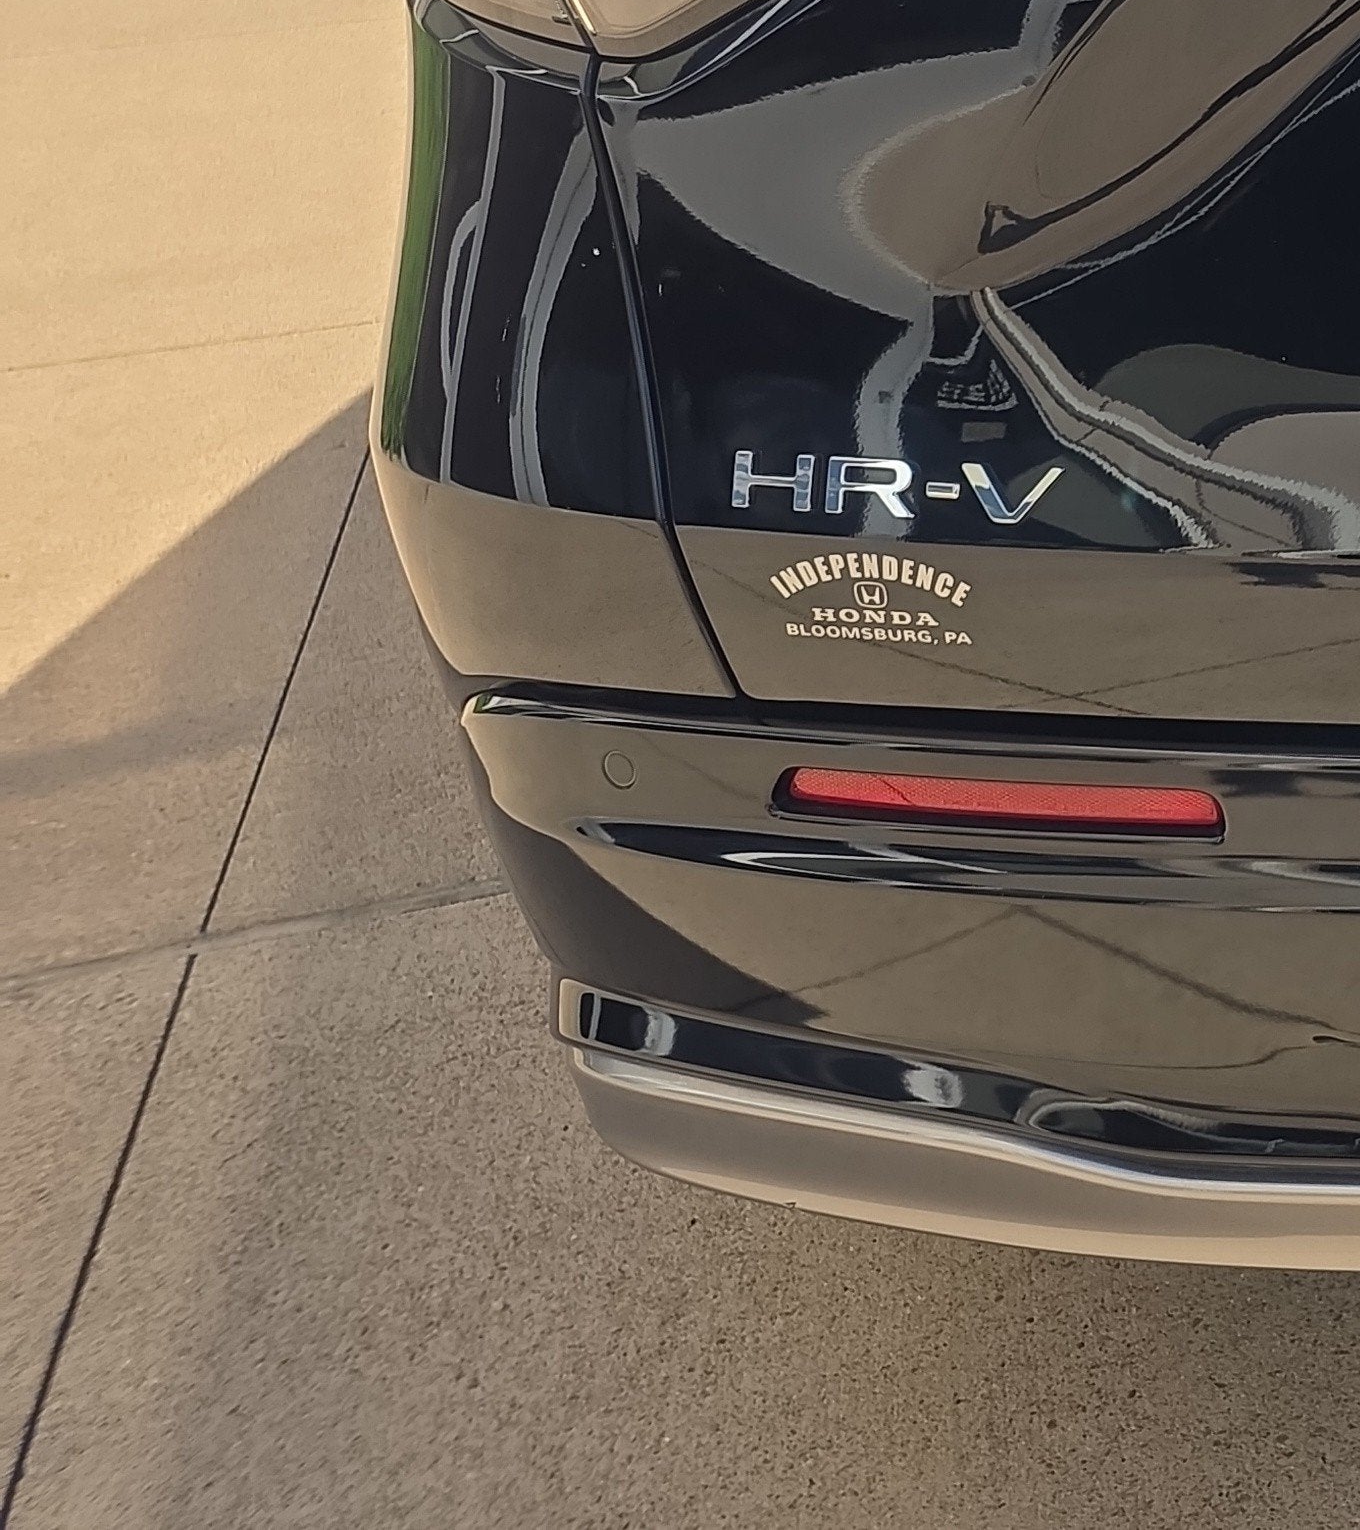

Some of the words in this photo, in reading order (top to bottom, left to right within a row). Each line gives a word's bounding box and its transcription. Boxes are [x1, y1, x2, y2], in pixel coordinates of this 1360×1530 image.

[731, 450, 1066, 525] HR-V
[769, 551, 973, 608] INDEPENDENCE
[785, 622, 939, 646] BLOOMSBURG,
[944, 631, 973, 645] PA
[811, 607, 940, 627] HONDA
